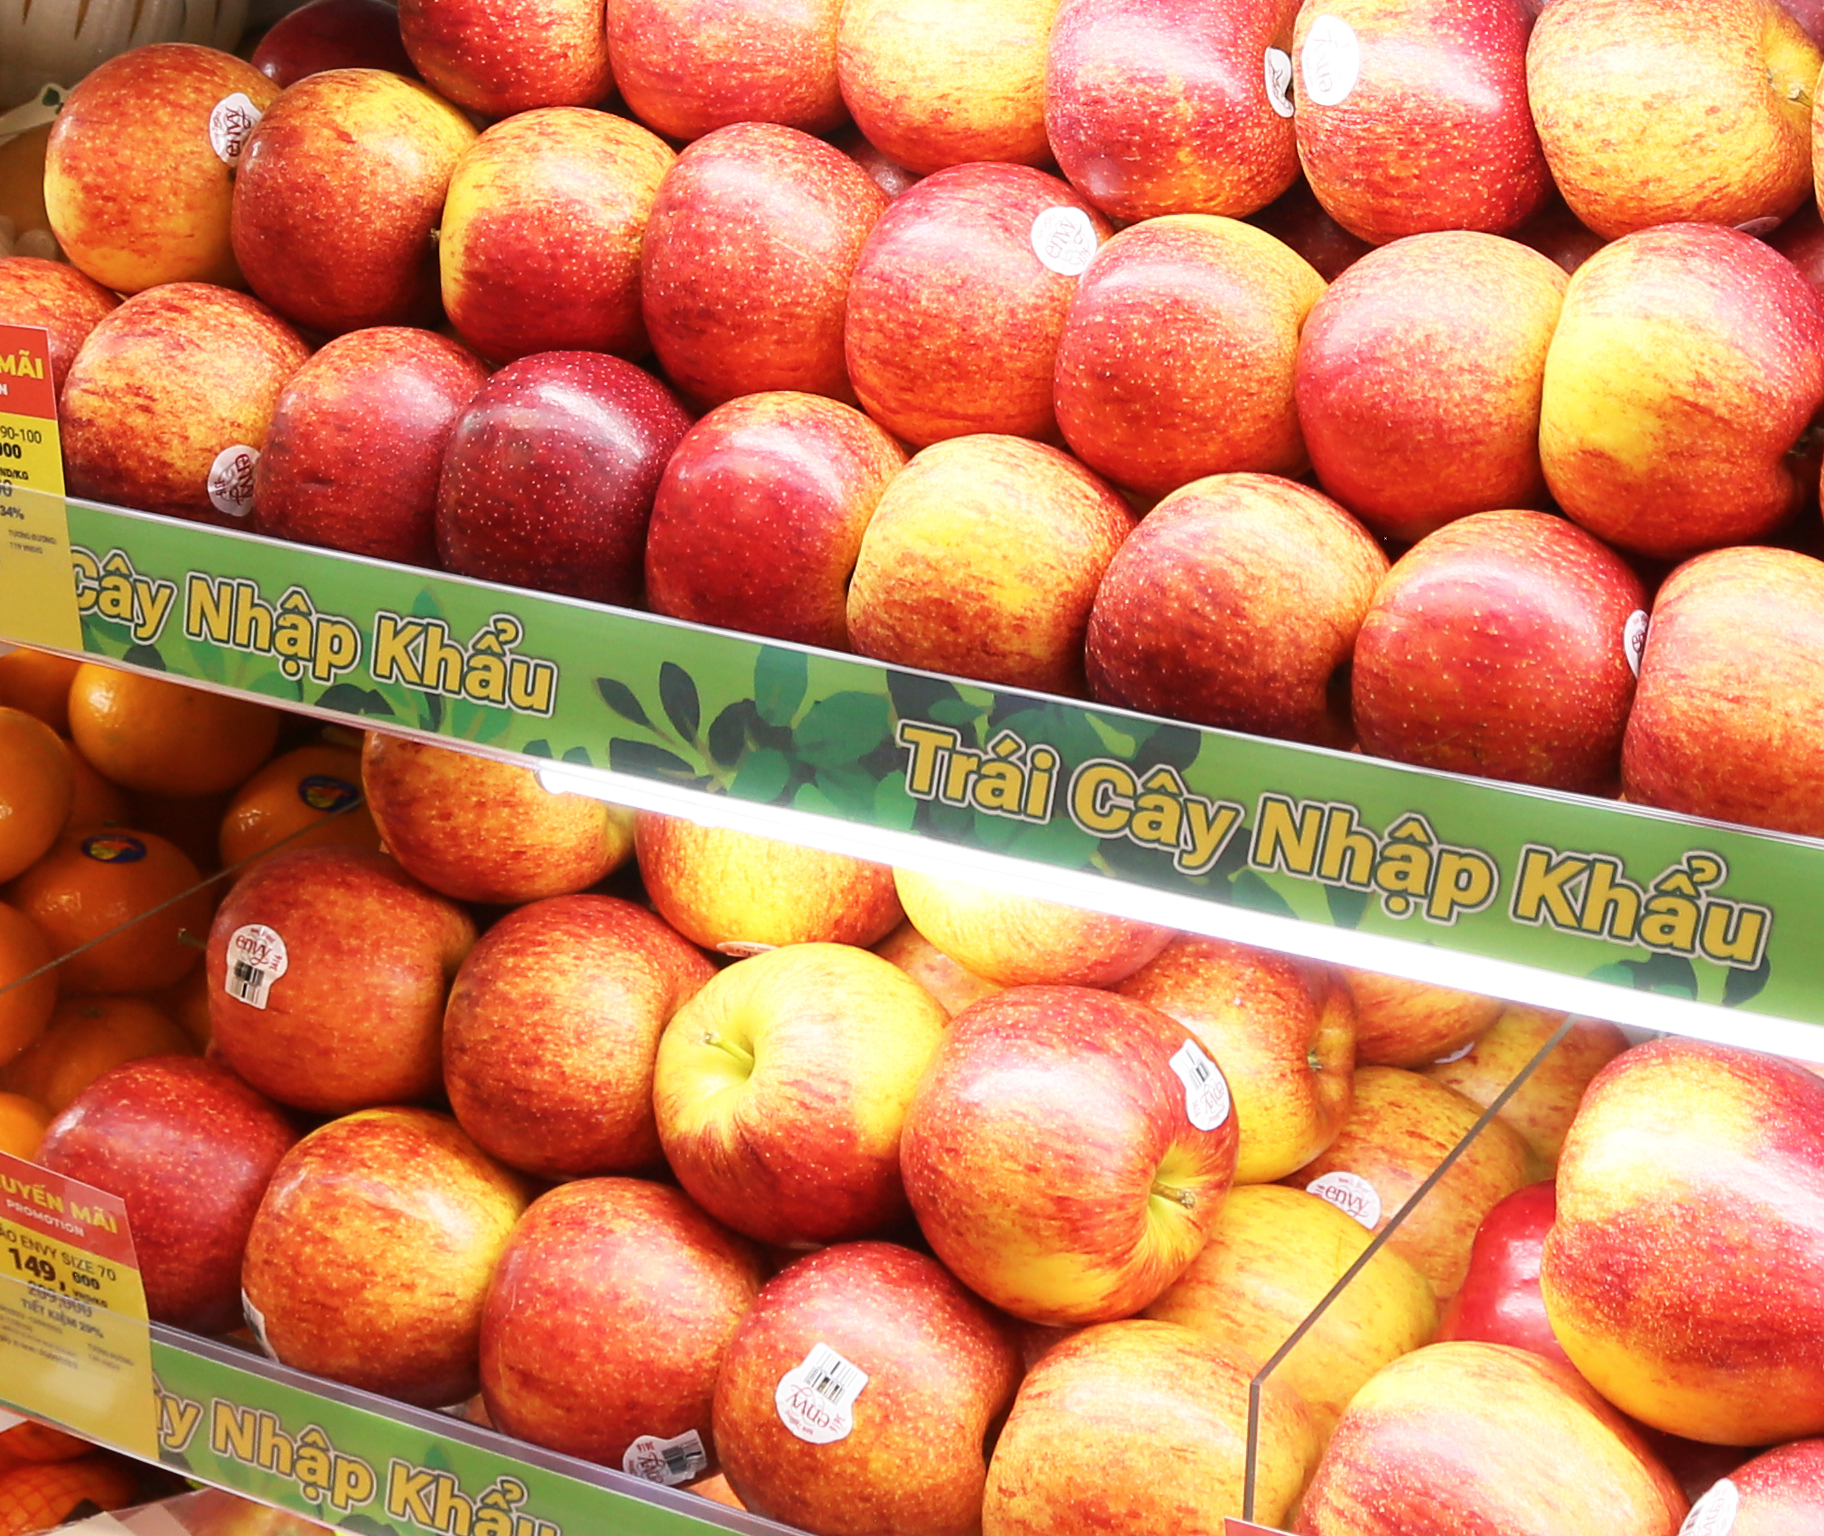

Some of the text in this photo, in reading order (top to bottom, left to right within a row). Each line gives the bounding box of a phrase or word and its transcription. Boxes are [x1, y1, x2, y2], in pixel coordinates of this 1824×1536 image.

[0, 424, 42, 444] 90-100
[184, 571, 361, 682] Nhập
[373, 612, 558, 718] Khẩu
[897, 716, 1770, 973] Trái Cây Nhập Khẩu
[236, 934, 273, 965] envy
[5, 1198, 85, 1237] PROMOTION
[69, 1201, 118, 1234] MÃI
[1324, 1184, 1369, 1219] envy
[8, 1247, 101, 1292] 149, 000
[21, 1234, 58, 1260] ENVY
[60, 1251, 94, 1274] SIZE
[97, 1263, 117, 1282] 70
[787, 1383, 831, 1432] envy
[210, 1398, 376, 1514] Nhập
